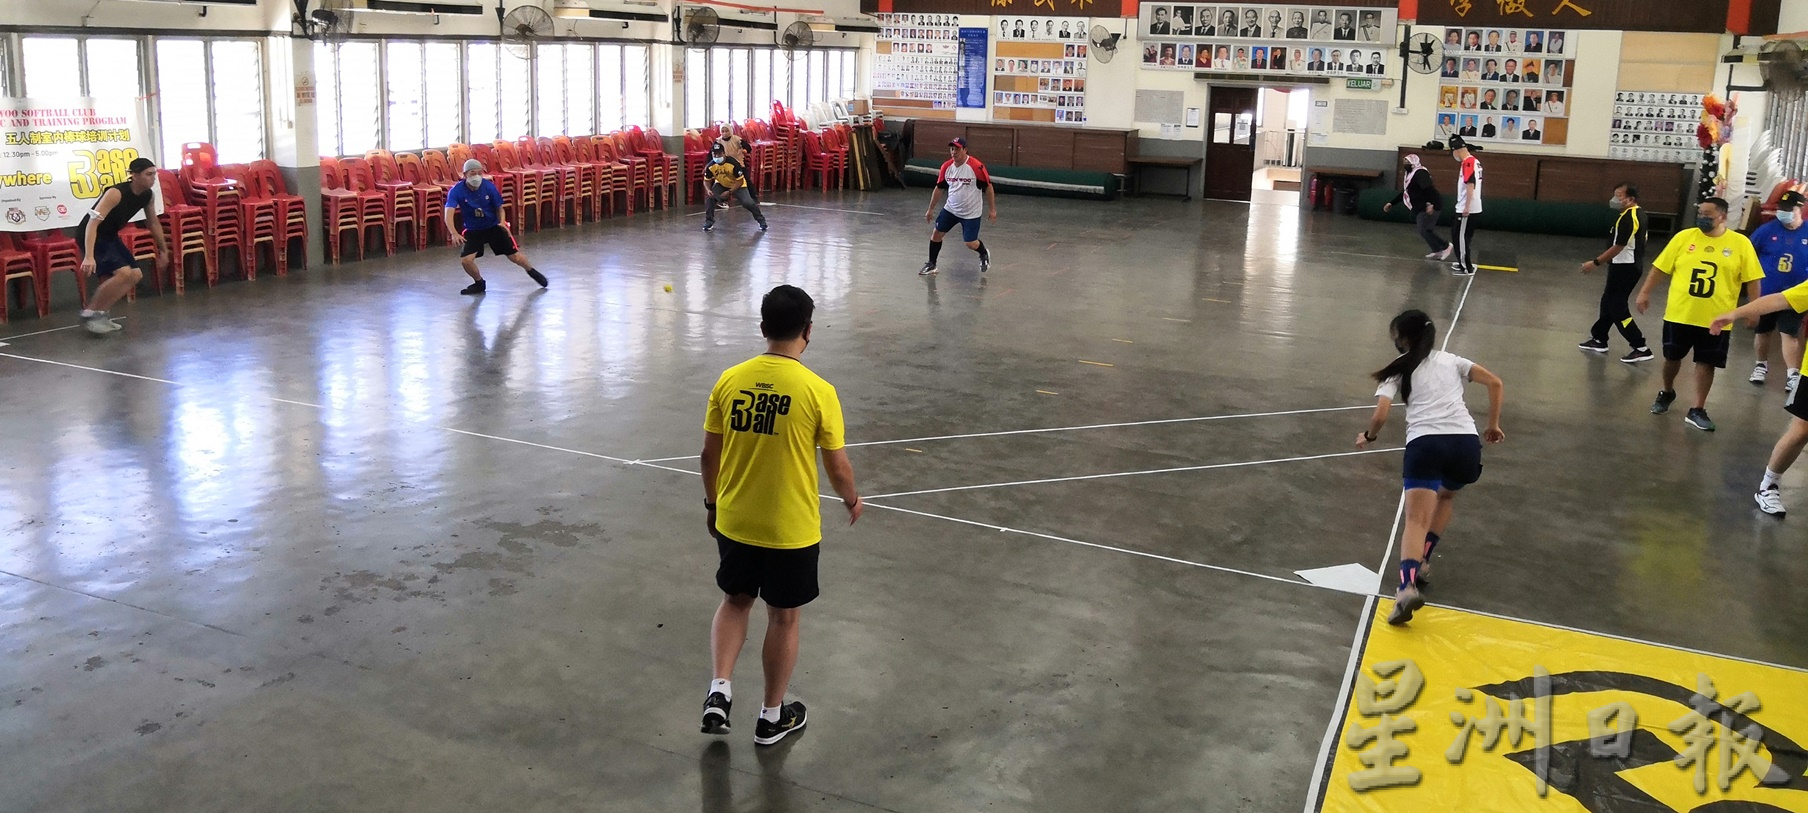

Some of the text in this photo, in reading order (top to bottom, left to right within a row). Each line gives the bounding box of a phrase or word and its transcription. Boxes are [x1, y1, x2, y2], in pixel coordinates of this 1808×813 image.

[1347, 80, 1371, 88] KELUAR
[21, 108, 69, 118] SOFTBALL
[72, 108, 96, 117] CLUB
[10, 118, 29, 128] AND
[33, 118, 79, 127] TRAINING
[82, 117, 127, 126] PROGRAM
[5, 128, 131, 145] 五人制室内棒球培训计划
